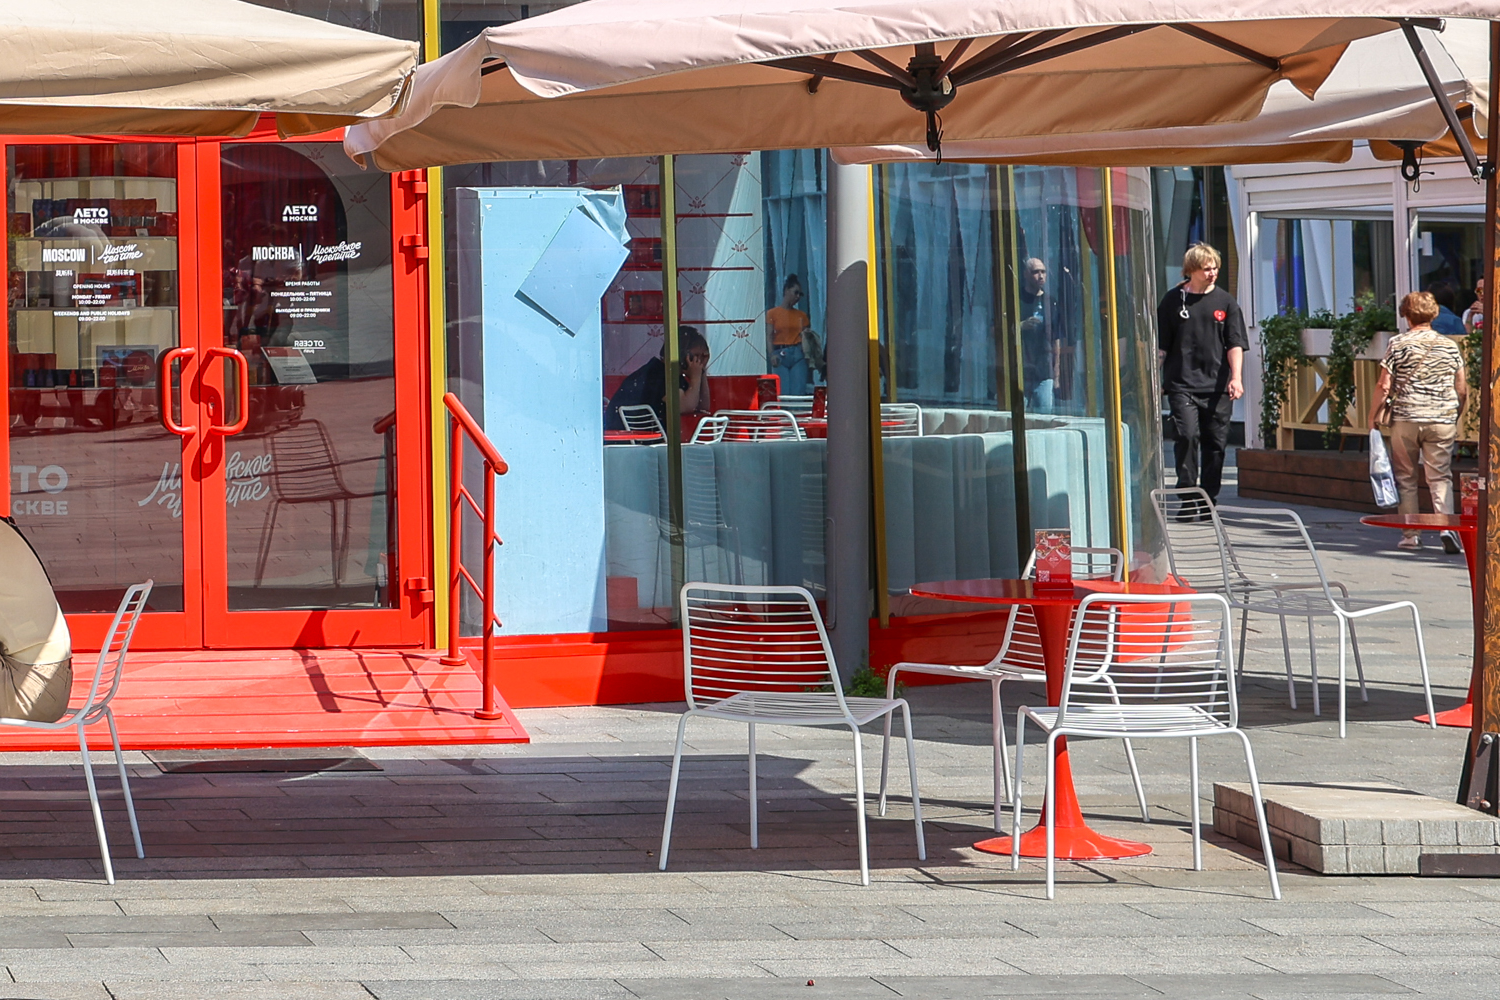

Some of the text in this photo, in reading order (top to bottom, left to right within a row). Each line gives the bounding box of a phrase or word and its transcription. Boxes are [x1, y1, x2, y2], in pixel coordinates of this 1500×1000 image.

[73, 208, 109, 218] ЛЕТО
[282, 205, 318, 215] ЛЕТО
[42, 249, 86, 262] MOSCOW
[97, 243, 138, 261] Moscow
[252, 246, 295, 260] МОСКВА
[306, 241, 362, 261] Московское
[12, 499, 69, 516] СКВЕ
